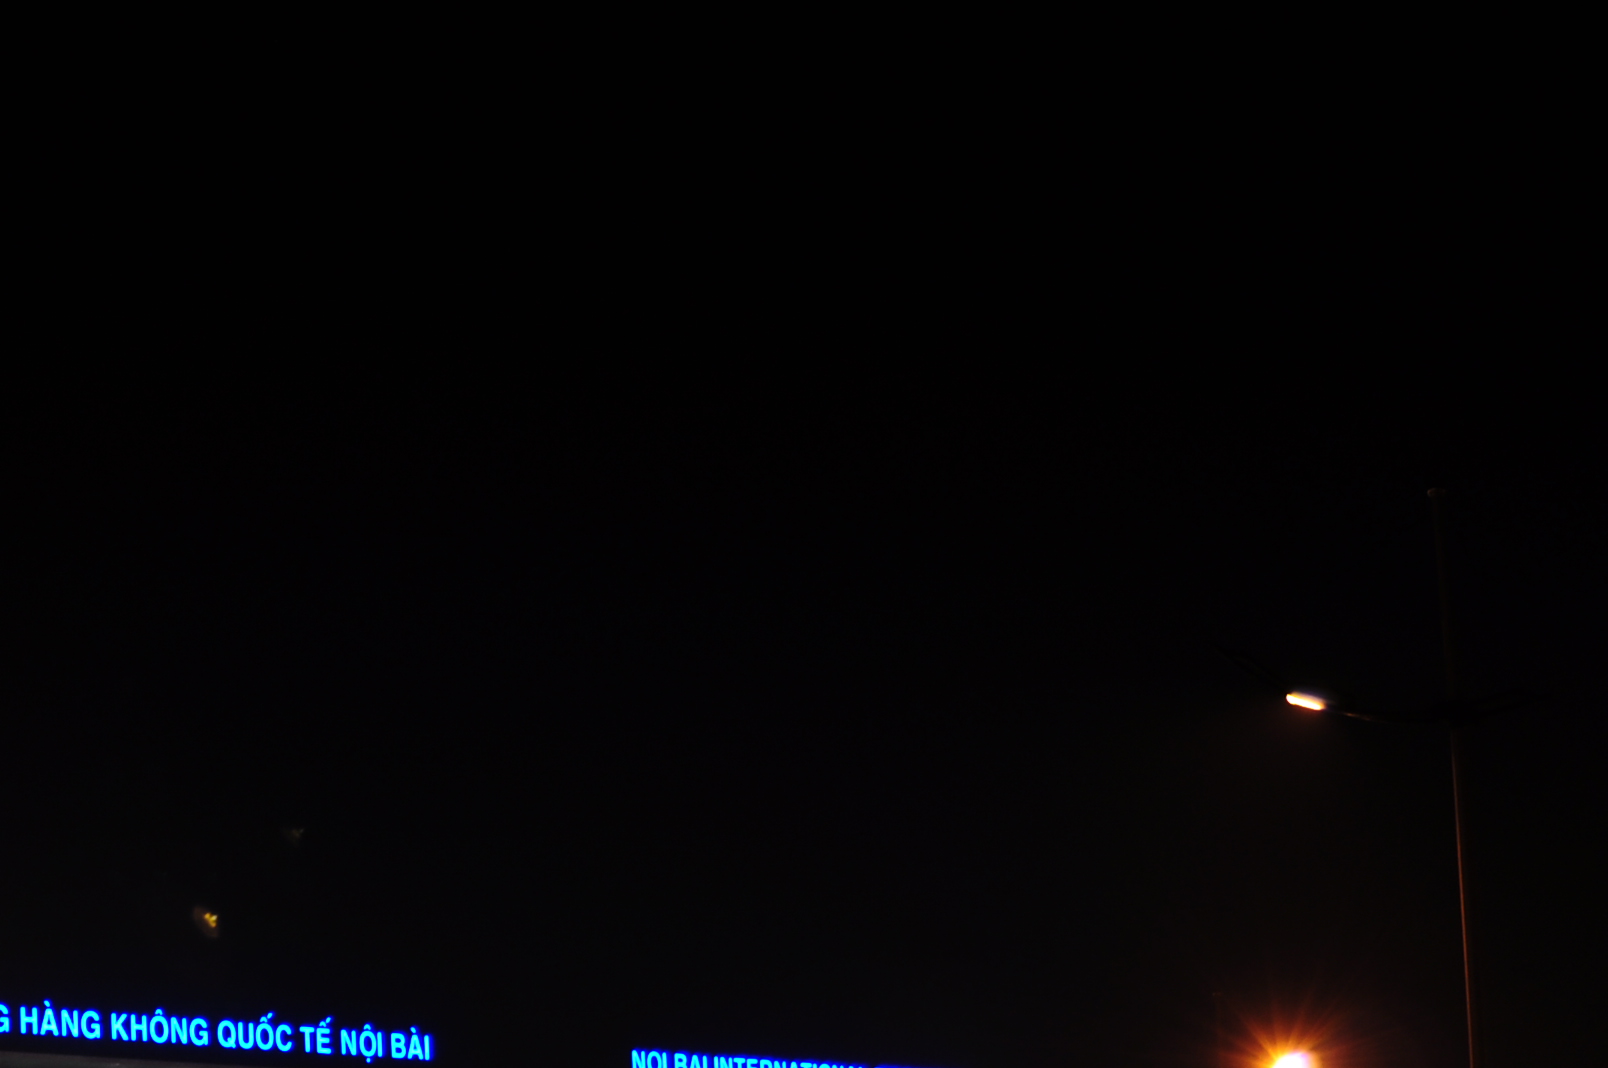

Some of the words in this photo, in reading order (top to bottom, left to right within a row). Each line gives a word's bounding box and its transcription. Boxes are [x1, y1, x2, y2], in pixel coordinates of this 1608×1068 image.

[19, 1000, 102, 1040] HÀNG
[110, 1008, 210, 1047] KHÔNG
[217, 1012, 294, 1052] QUỐC
[299, 1016, 334, 1055] TẾ
[340, 1023, 385, 1063] NỘI
[389, 1026, 433, 1061] BÀI
